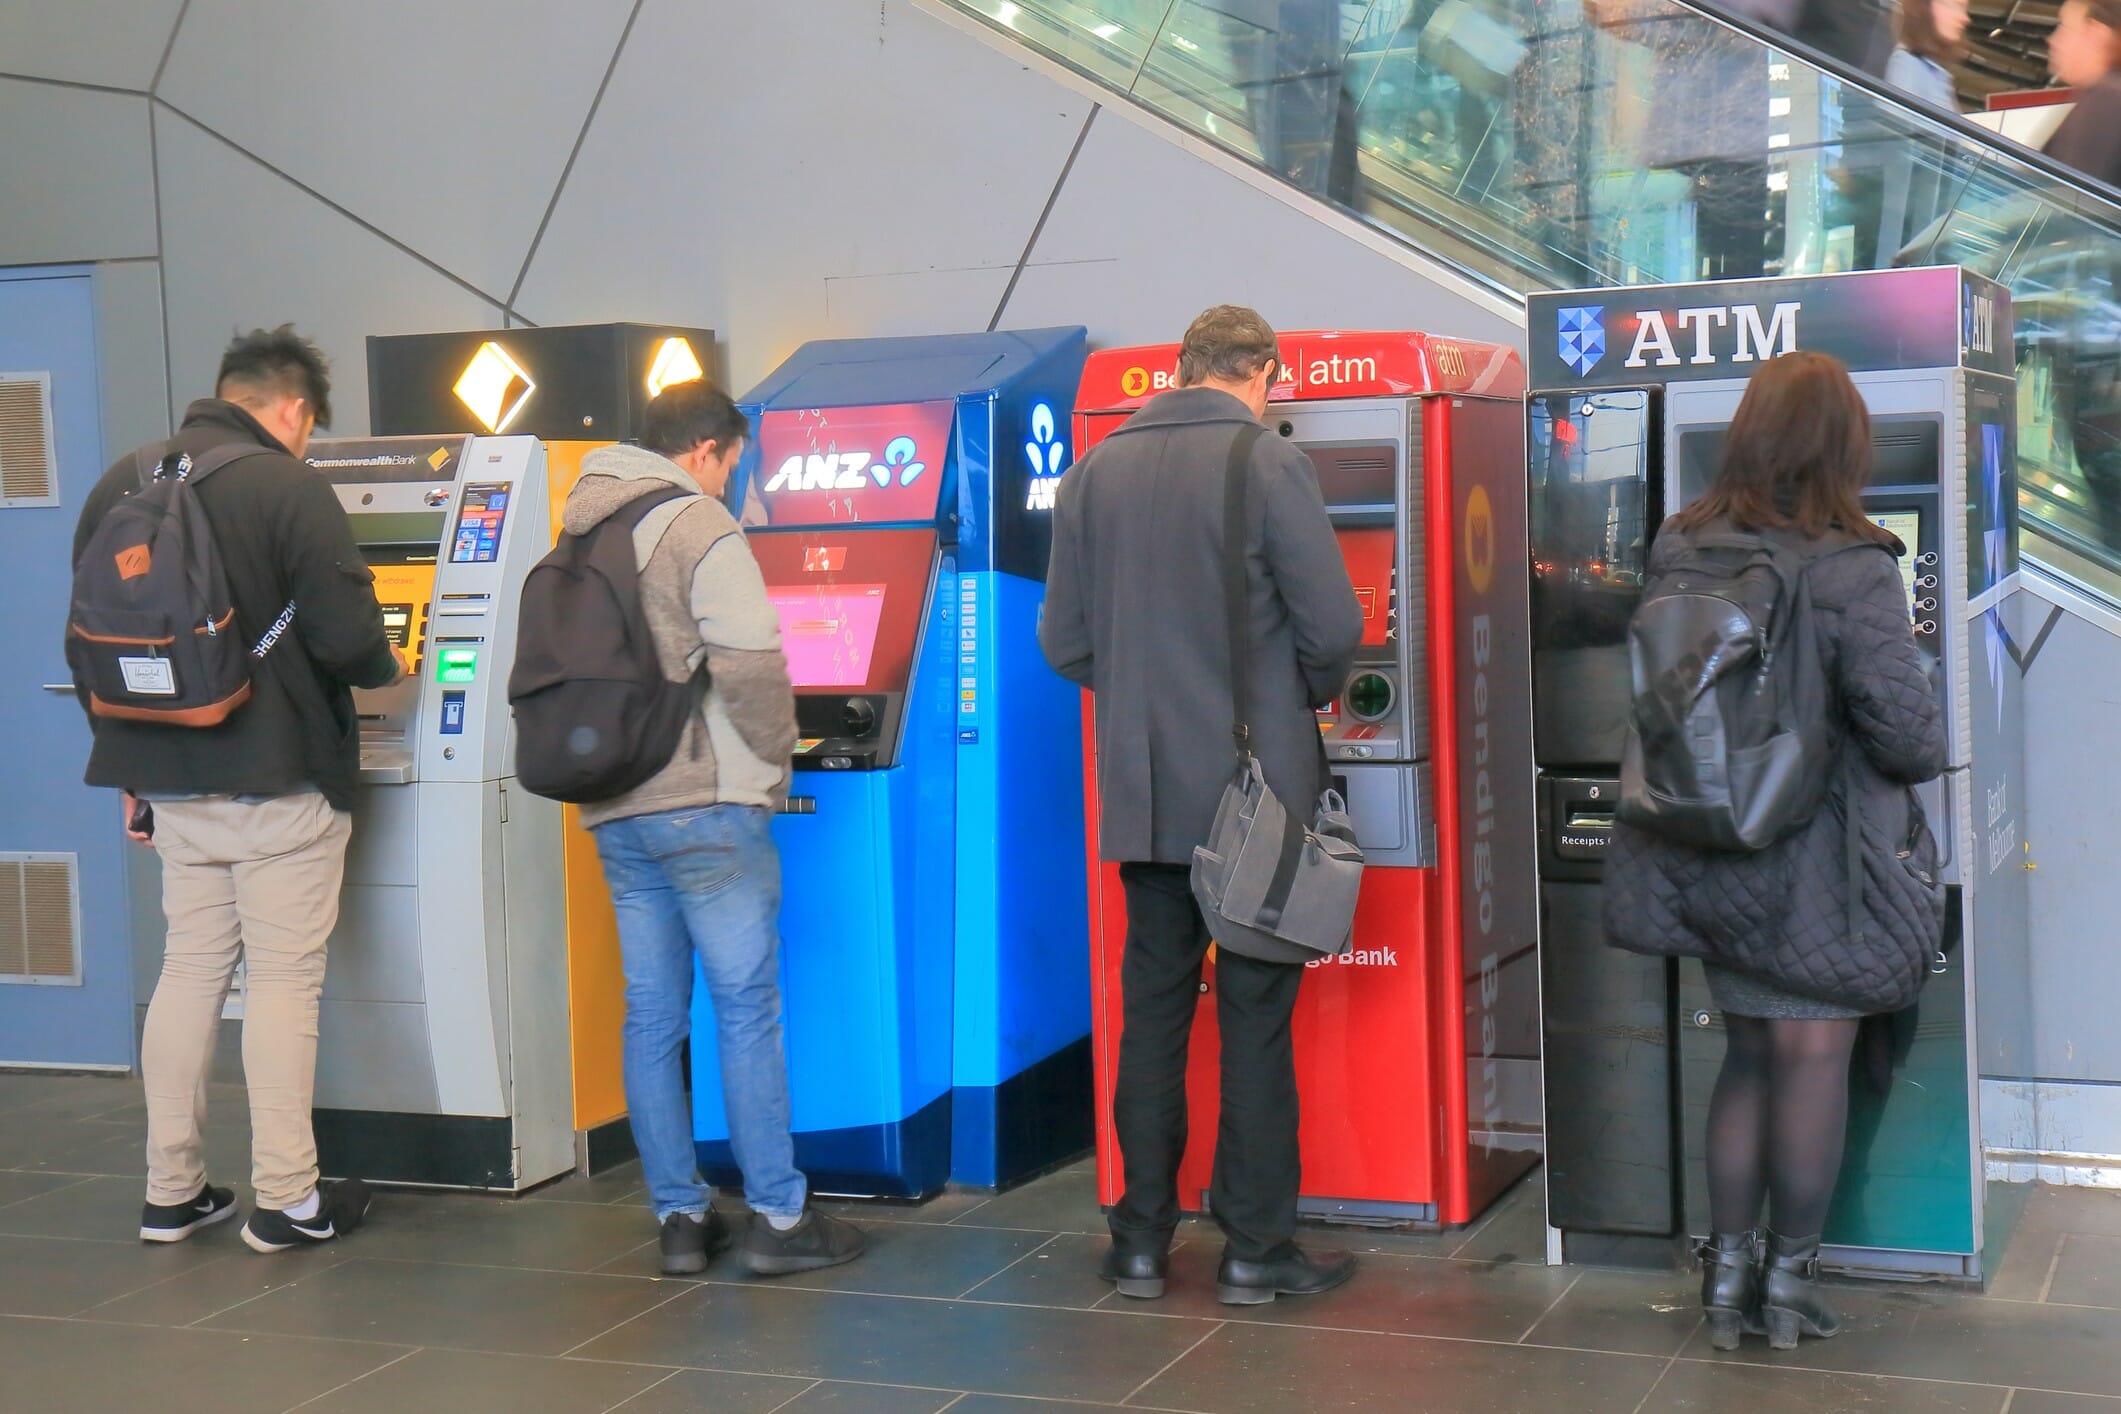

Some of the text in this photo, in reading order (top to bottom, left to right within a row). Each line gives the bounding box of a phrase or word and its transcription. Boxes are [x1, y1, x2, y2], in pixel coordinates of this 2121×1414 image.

[1624, 302, 1800, 368] ATM
[1972, 295, 1993, 354] ATM
[1309, 353, 1376, 385] atm
[1436, 343, 1467, 376] atm
[305, 455, 417, 468] CommonwealthBank
[763, 452, 872, 492] ANZ
[1561, 836, 1605, 847] Receipts
[1472, 614, 1502, 1160] Bendigo Bank
[1338, 946, 1398, 966] Bank
